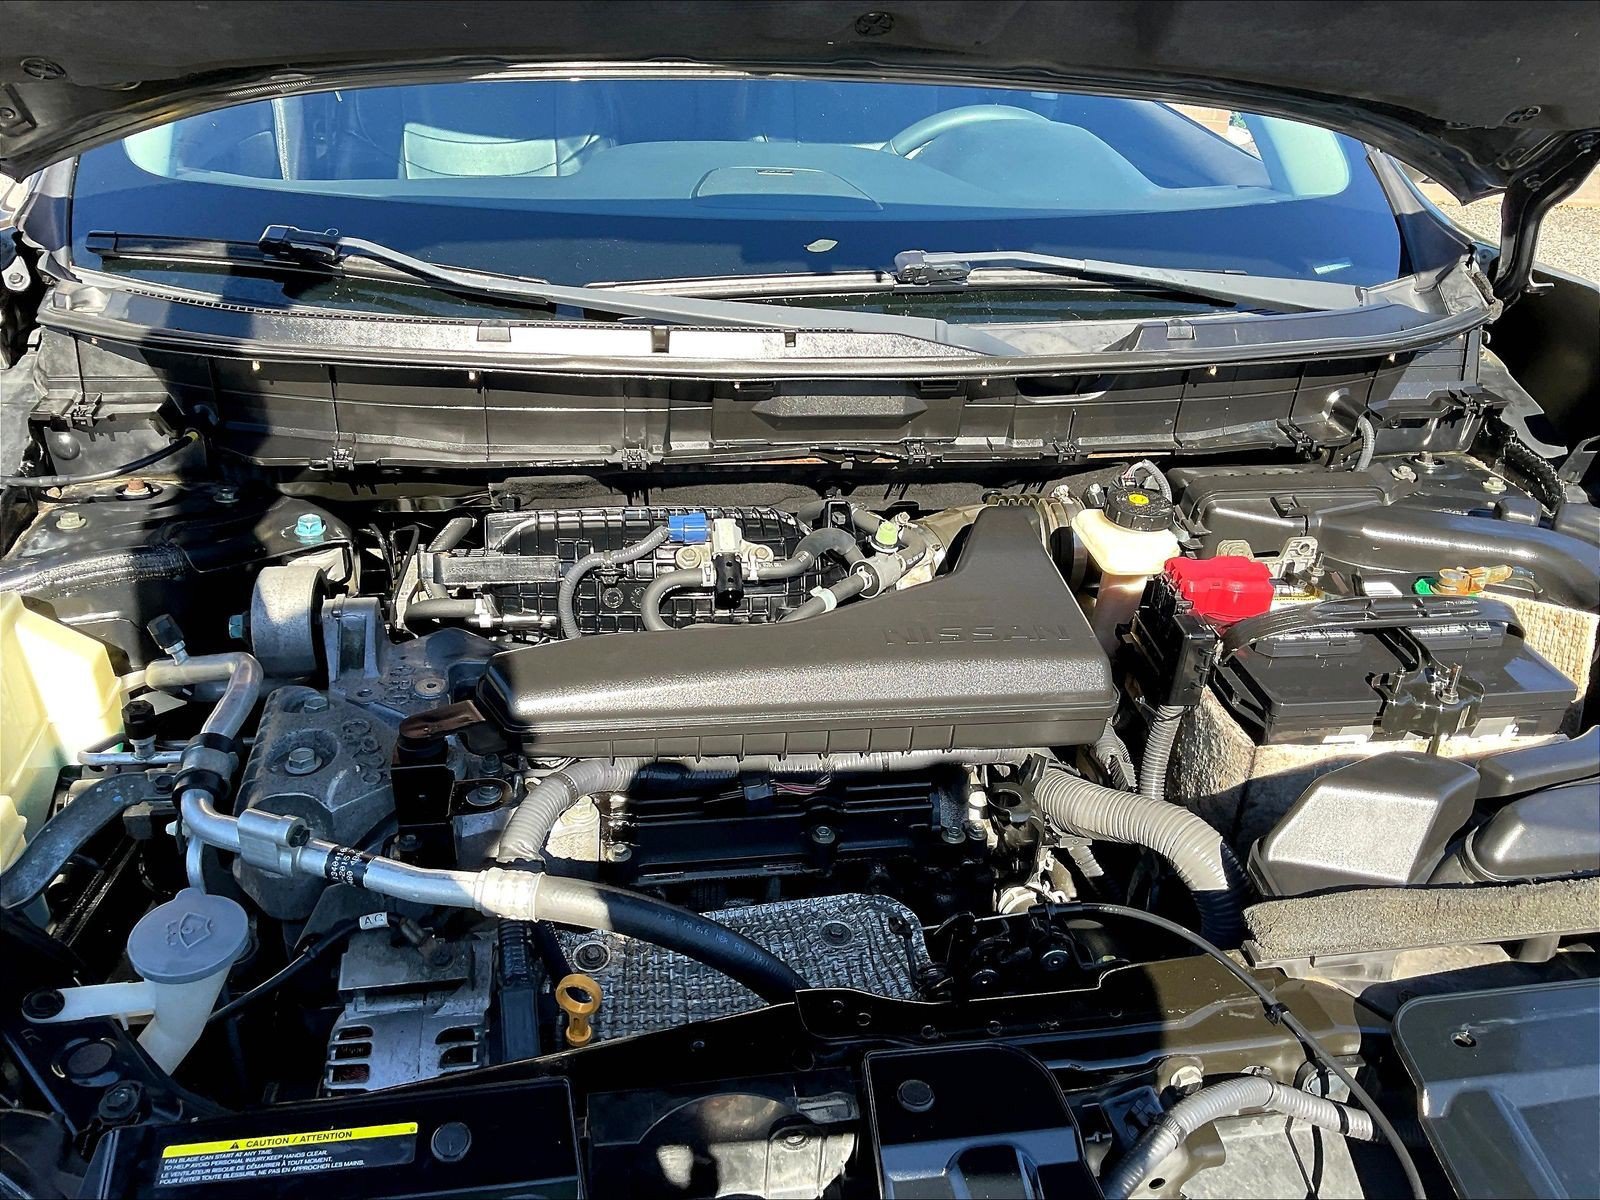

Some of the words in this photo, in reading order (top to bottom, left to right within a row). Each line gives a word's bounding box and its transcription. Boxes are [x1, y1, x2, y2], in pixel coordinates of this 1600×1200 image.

[881, 624, 1073, 645] NISSAN
[246, 1137, 290, 1148] CAUTION
[300, 1130, 353, 1143] ATTENTION
[200, 1154, 214, 1162] CAN
[215, 1152, 235, 1160] START
[283, 1151, 305, 1159] HANDS
[287, 1158, 304, 1166] TOUT
[291, 1162, 331, 1172] APPROCHER
